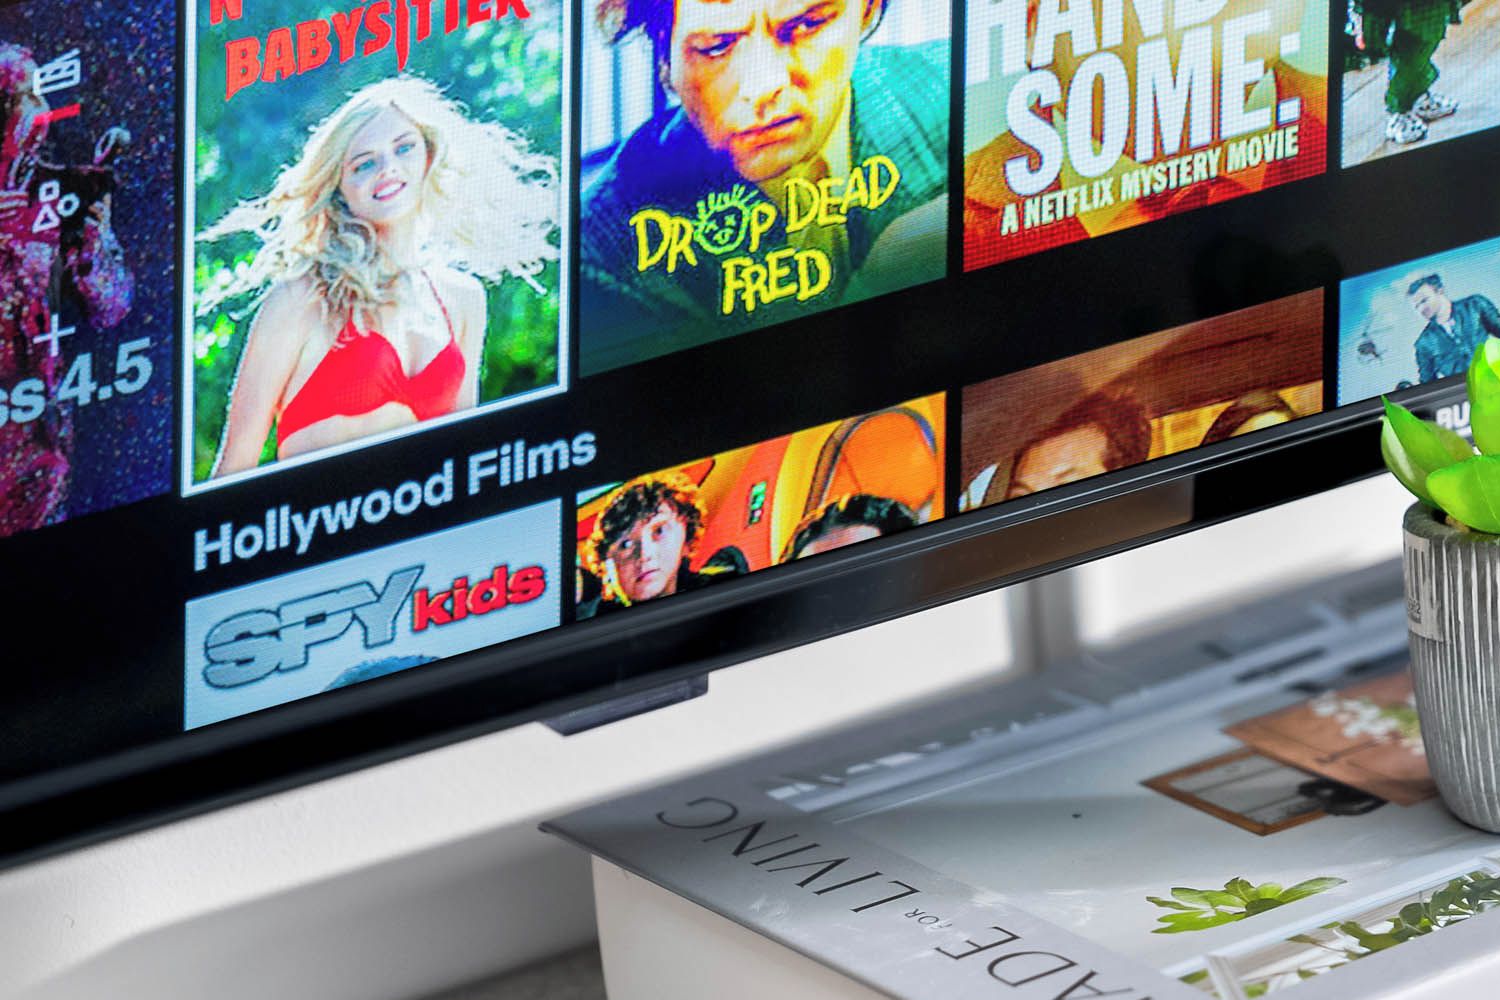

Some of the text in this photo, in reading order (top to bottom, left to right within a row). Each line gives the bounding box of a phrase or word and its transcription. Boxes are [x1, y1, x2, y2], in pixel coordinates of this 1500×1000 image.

[963, 0, 1232, 86] HA
[629, 155, 901, 273] DROP DEAD
[1000, 124, 1300, 237] A NETFLIX MYSTERY MOVIE
[721, 248, 832, 315] FRED
[57, 336, 153, 407] 4.5
[193, 431, 598, 572] Hollywood Films
[203, 564, 547, 690] SPY kids
[656, 796, 921, 914] LIVING
